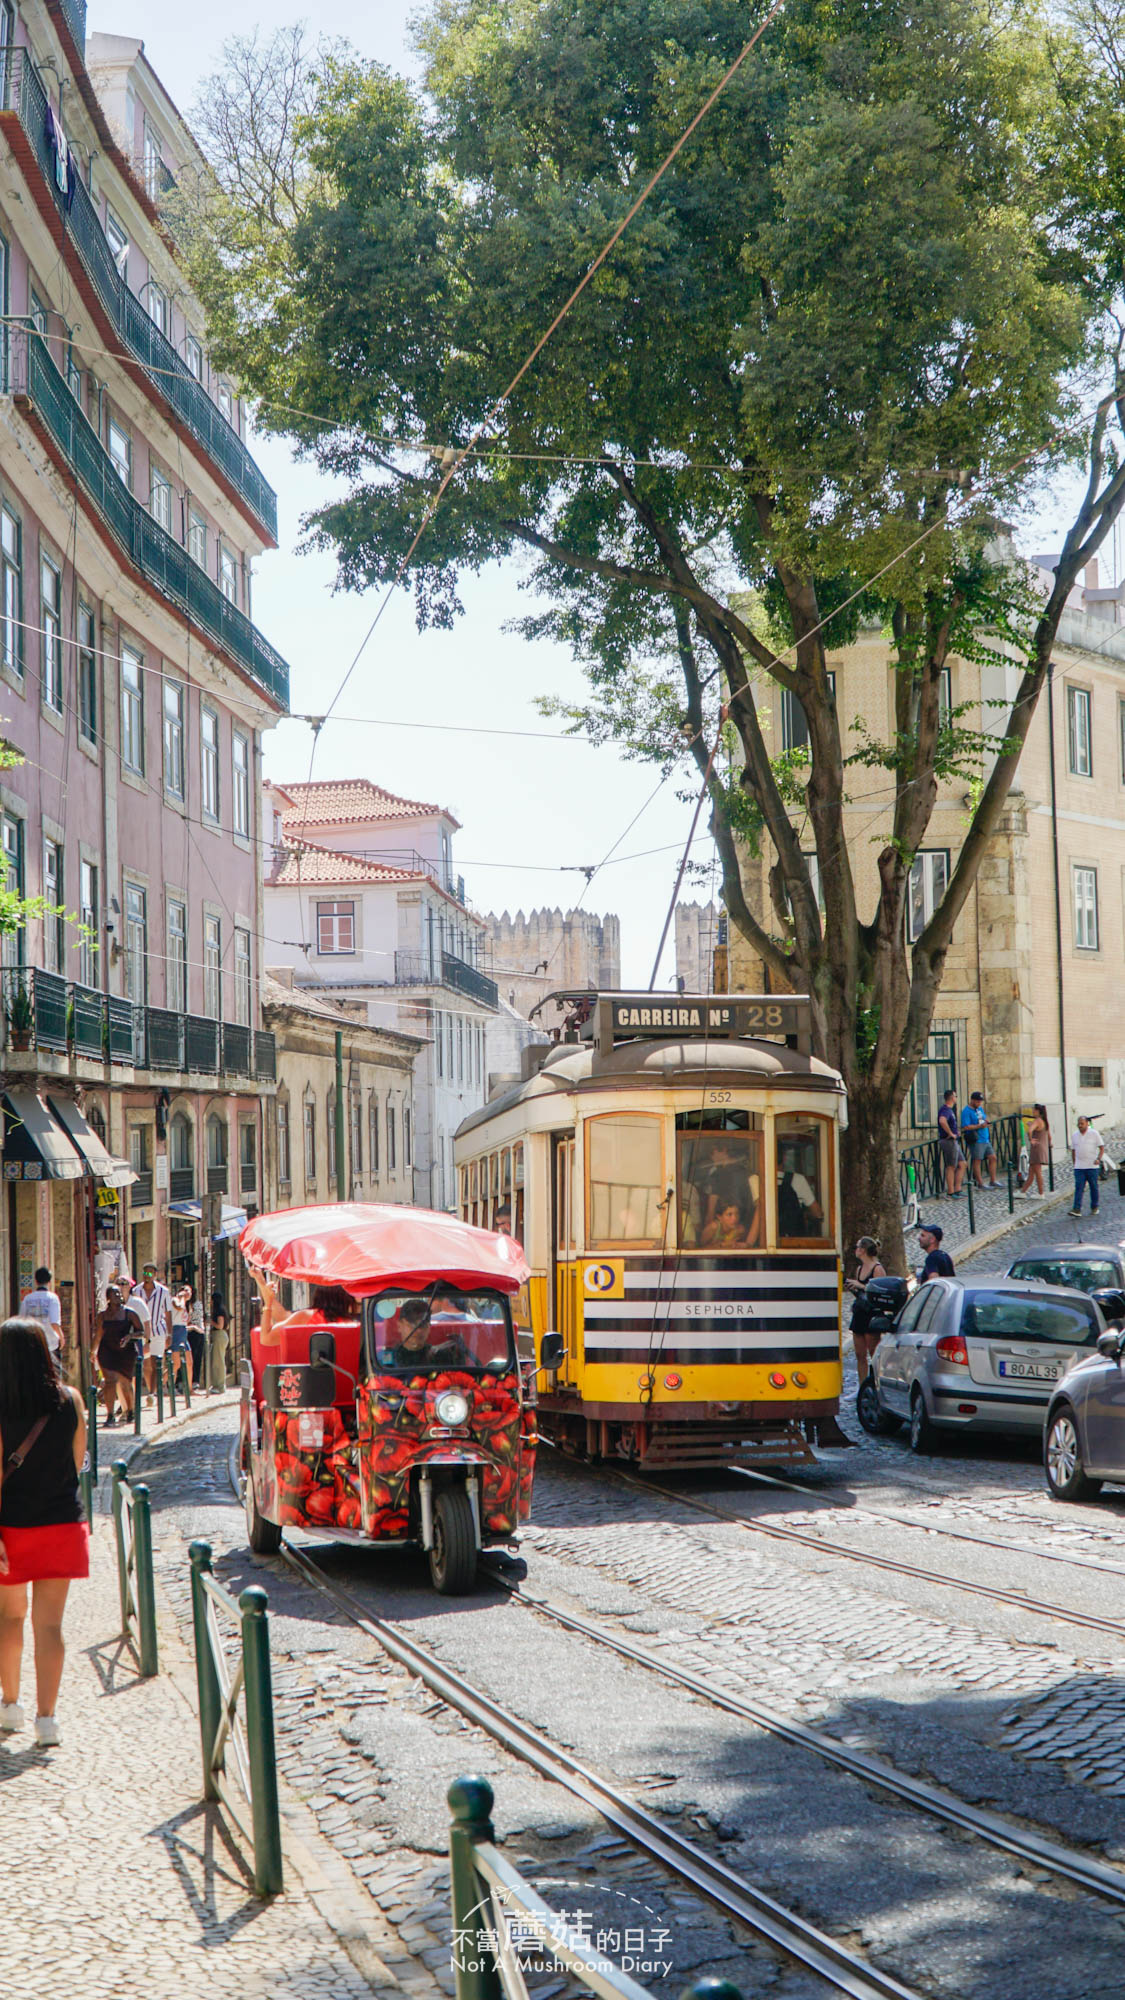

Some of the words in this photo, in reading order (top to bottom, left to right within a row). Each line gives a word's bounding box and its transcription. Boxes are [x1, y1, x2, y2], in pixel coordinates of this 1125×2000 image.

[617, 1008, 700, 1026] CARREIRA
[748, 1005, 783, 1027] 28
[709, 1091, 732, 1103] 552
[101, 1190, 115, 1204] 10
[685, 1304, 755, 1315] SEPHORA
[1011, 1364, 1025, 1375] 80
[1026, 1365, 1042, 1377] AL
[1044, 1366, 1058, 1378] 39
